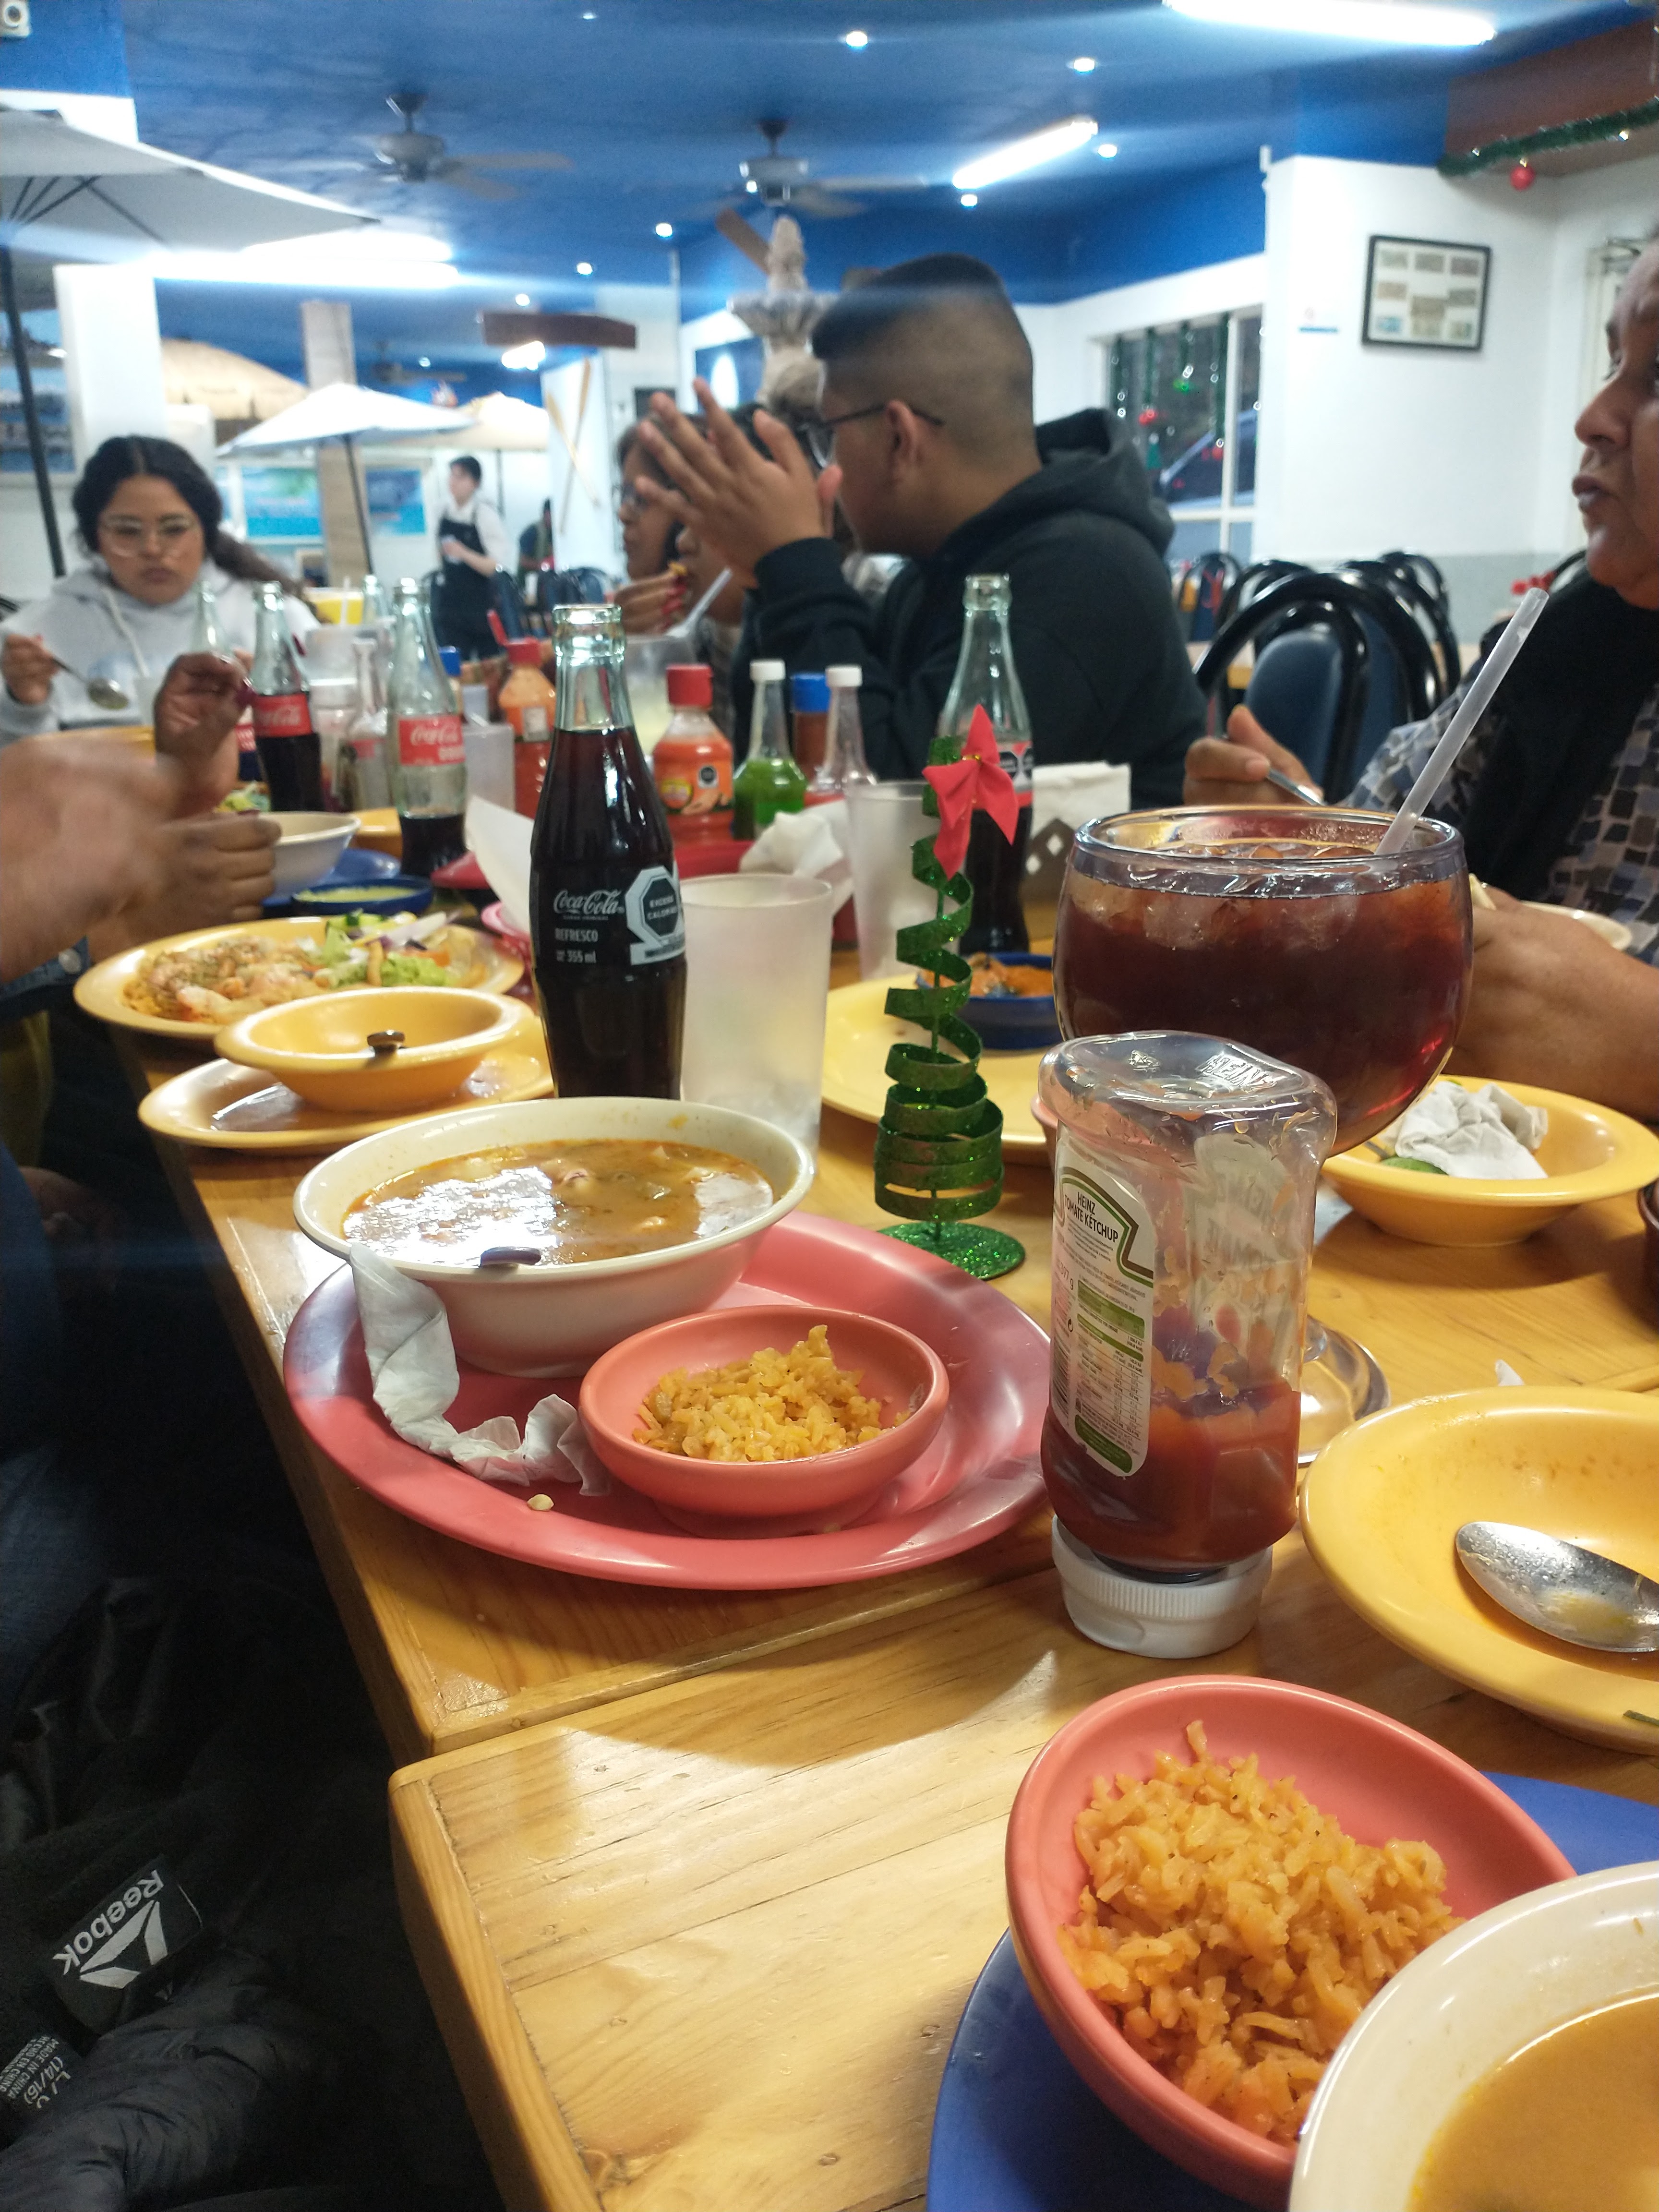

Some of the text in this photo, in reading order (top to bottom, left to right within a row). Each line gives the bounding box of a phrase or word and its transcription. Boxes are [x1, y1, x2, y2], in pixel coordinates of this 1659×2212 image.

[553, 889, 622, 915] Coca-Cola
[555, 927, 599, 942] REFRESCO
[1078, 1191, 1095, 1215] HEINZ
[1065, 1194, 1083, 1222] TOMATE
[1085, 1213, 1118, 1242] KÉTCHUP
[1070, 1278, 1073, 1290] g
[52, 1870, 164, 1975] Reebok
[35, 2038, 59, 2063] MADE
[24, 2056, 63, 2104] (14/16)
[27, 2061, 39, 2075] IN
[7, 2071, 30, 2099] CHINA
